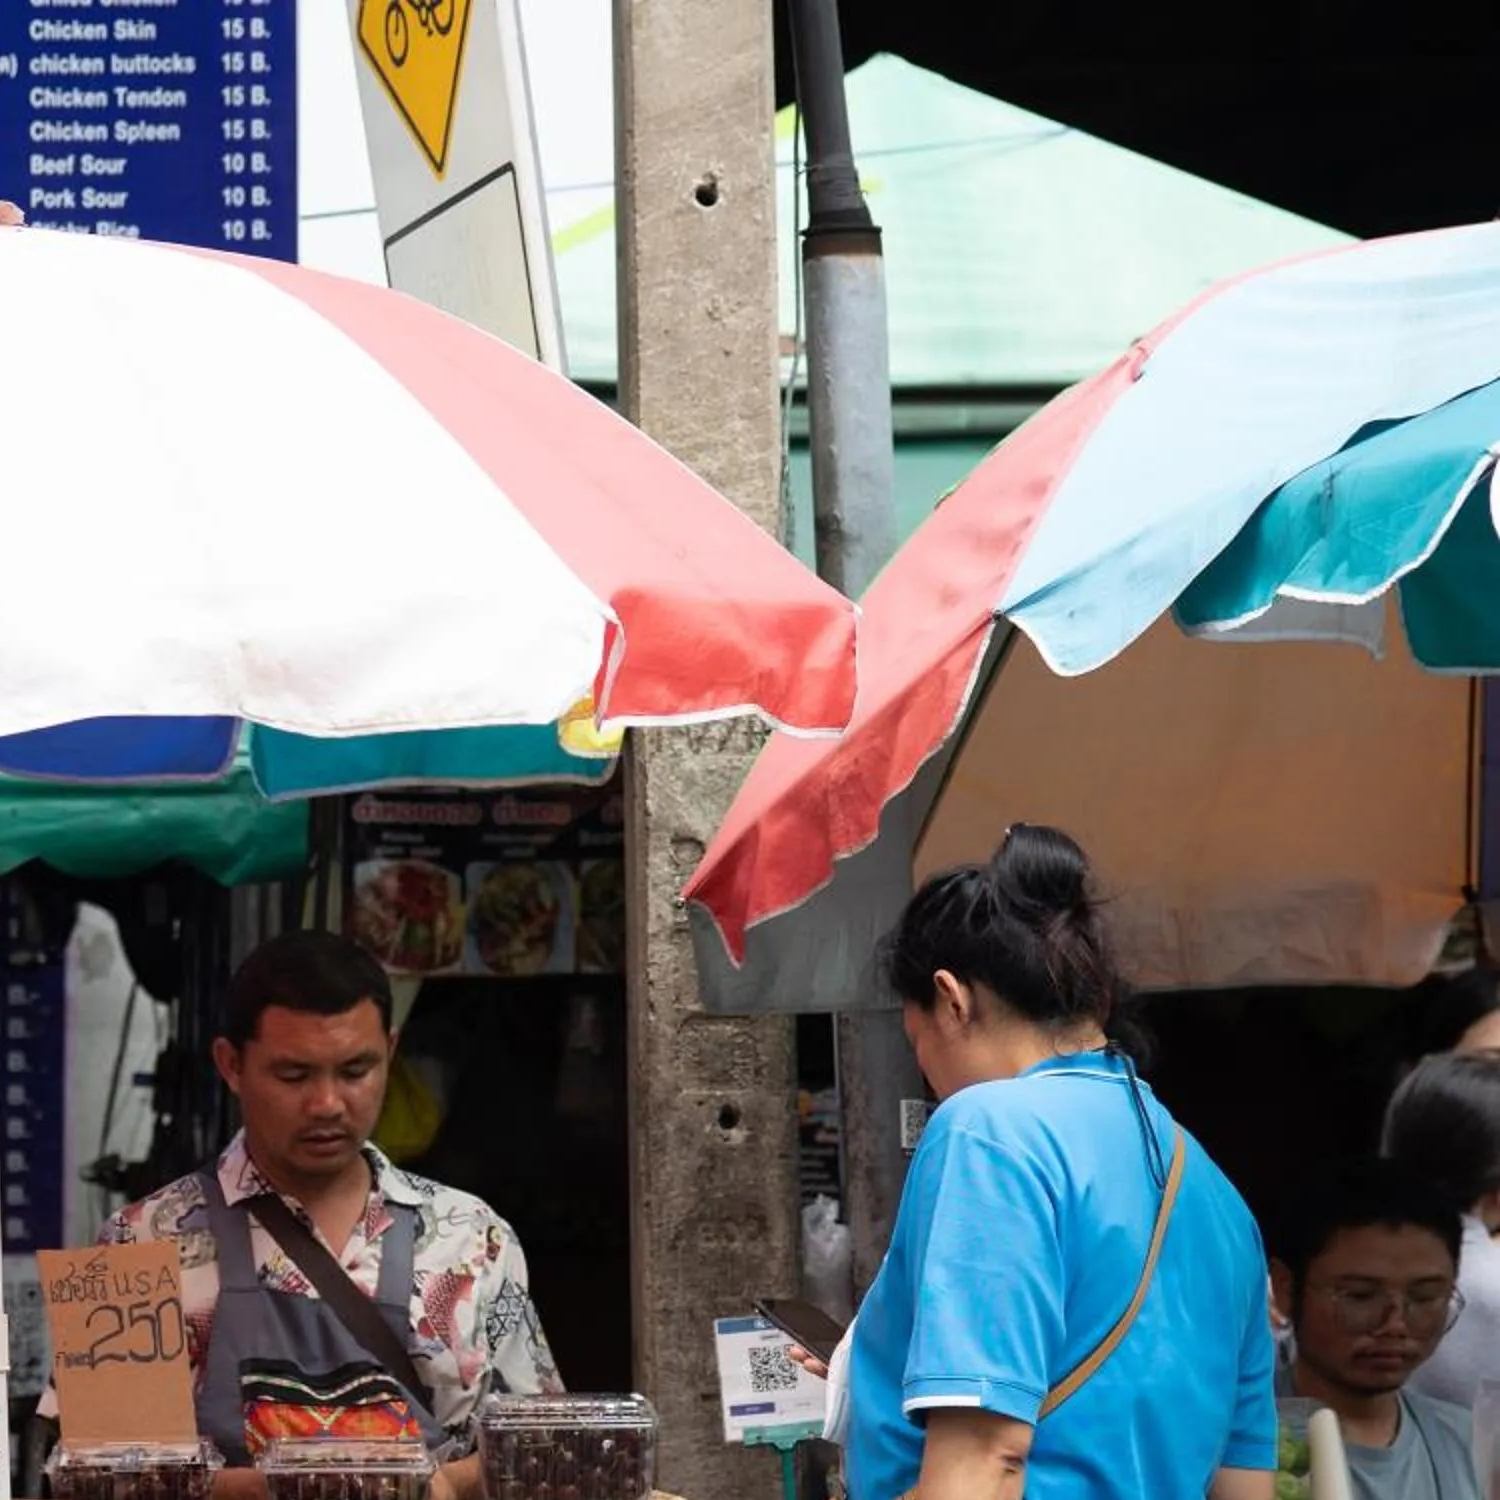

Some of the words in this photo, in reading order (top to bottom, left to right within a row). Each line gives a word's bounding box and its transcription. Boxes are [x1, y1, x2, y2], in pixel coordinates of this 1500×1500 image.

[29, 19, 107, 40] Chicken
[113, 19, 156, 41] Skin
[221, 19, 244, 39] 15
[250, 19, 271, 39] B.
[29, 54, 105, 74] chicken
[111, 54, 196, 74] buttocks
[221, 53, 244, 73] 15
[250, 53, 271, 73] B.
[29, 87, 107, 108] Chicken
[115, 87, 187, 107] Tendon
[221, 87, 244, 106] 15
[250, 87, 271, 106] B.
[29, 121, 107, 141] Chicken
[113, 121, 181, 144] Spleen
[221, 120, 244, 140] 15
[250, 120, 271, 140] B.
[30, 154, 76, 175] Beef
[80, 154, 127, 175] Sour
[221, 153, 244, 173] 10
[250, 153, 272, 173] B.
[30, 188, 75, 208] Pork
[81, 188, 128, 208] Sour
[222, 187, 245, 207] 10
[251, 187, 272, 207] B.
[222, 221, 245, 240] 10
[251, 221, 272, 240] B.
[84, 1297, 185, 1370] 250
